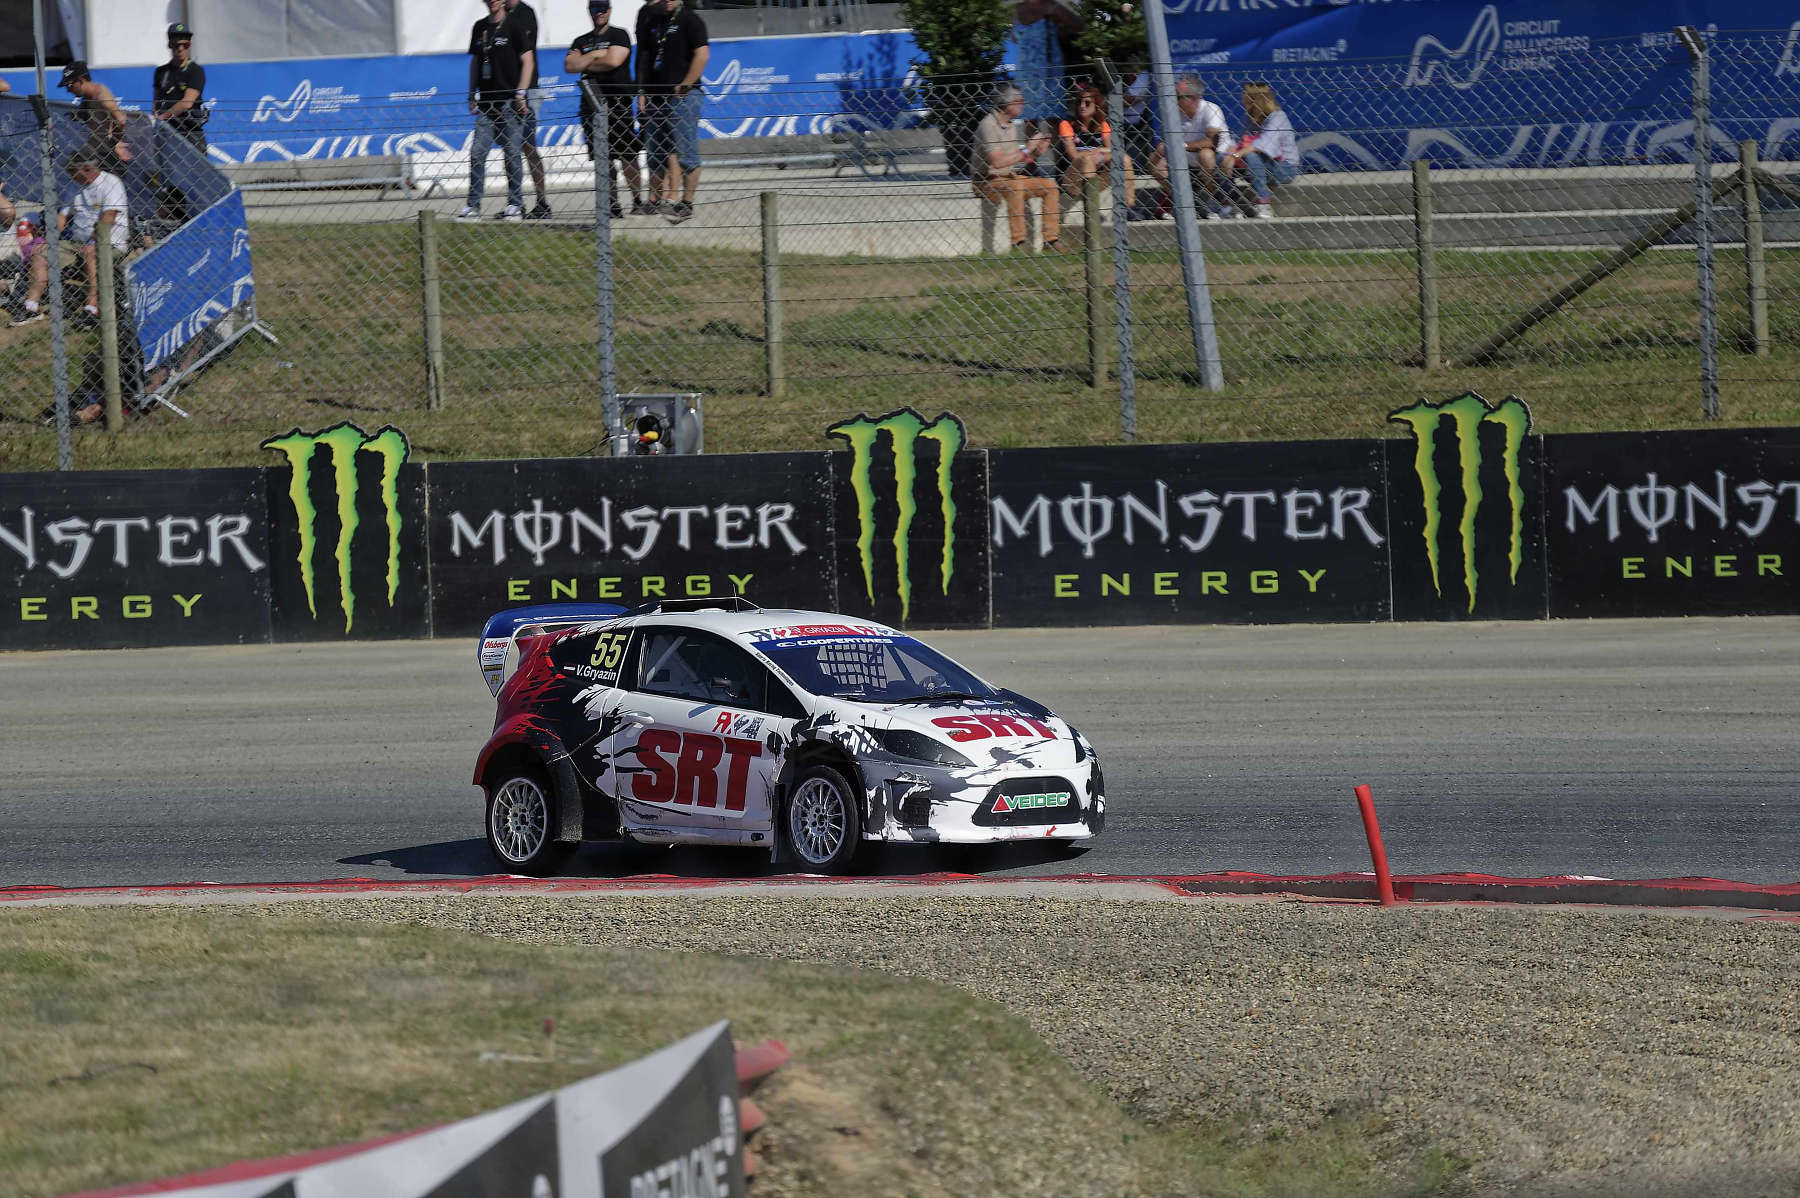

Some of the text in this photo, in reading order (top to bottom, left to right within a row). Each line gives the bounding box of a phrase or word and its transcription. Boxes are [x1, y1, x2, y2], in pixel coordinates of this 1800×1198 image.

[1504, 19, 1561, 36] CIRCUIT
[1271, 46, 1338, 63] BRETAGNE
[449, 497, 807, 566] MONSTER
[991, 480, 1385, 558] MONSTER
[1622, 554, 1784, 579] ENER
[507, 573, 754, 602] ENERGY
[1054, 568, 1327, 599] ENERGY
[20, 593, 203, 621] ERGY
[590, 632, 627, 669] 55
[576, 664, 617, 681] V.Gryazin
[931, 714, 1057, 743] SRT
[632, 728, 763, 811] SRT
[1005, 792, 1069, 810] VEIDEC
